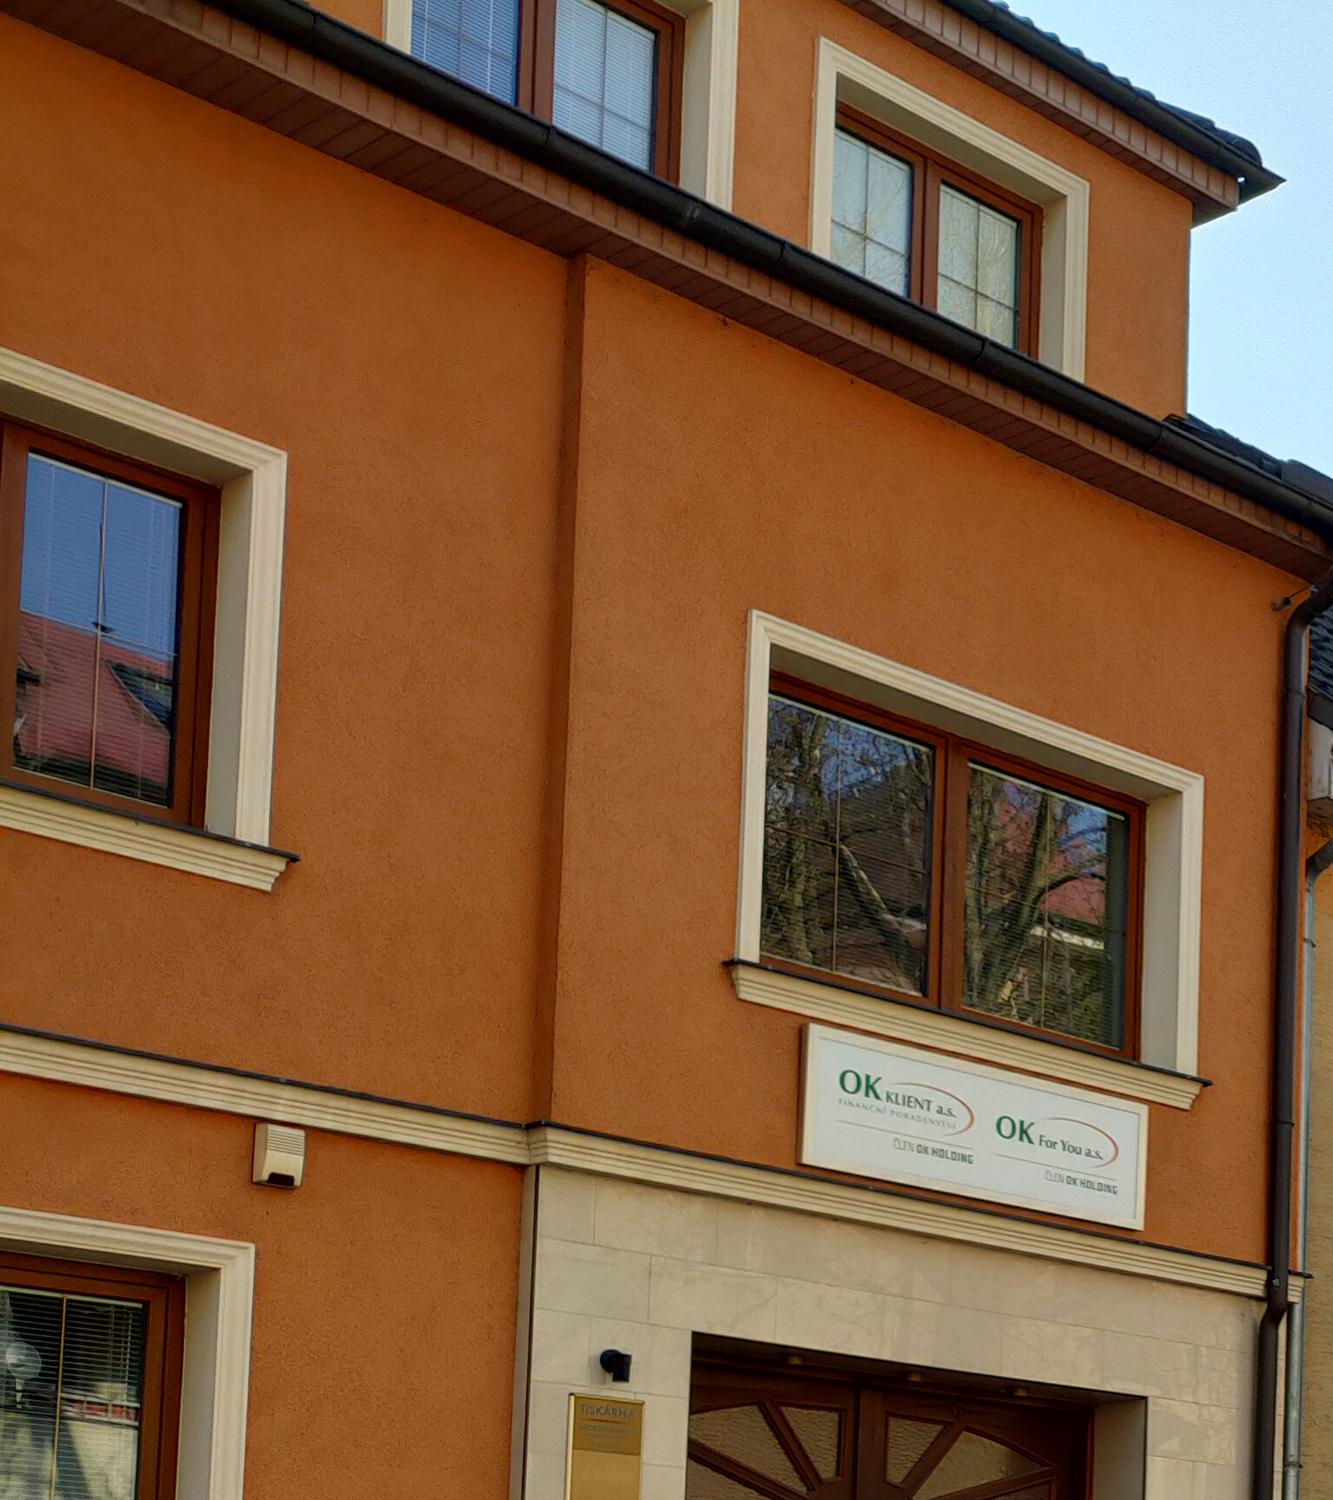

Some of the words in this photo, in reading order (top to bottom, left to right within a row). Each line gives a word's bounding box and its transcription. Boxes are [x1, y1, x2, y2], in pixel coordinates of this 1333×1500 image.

[839, 1069, 882, 1101] OK
[885, 1090, 933, 1112] KLIENT
[936, 1104, 957, 1118] a.s.
[931, 1147, 974, 1164] HOLDING
[995, 1115, 1035, 1145] OK
[1039, 1134, 1058, 1149] For
[1060, 1139, 1082, 1156] You
